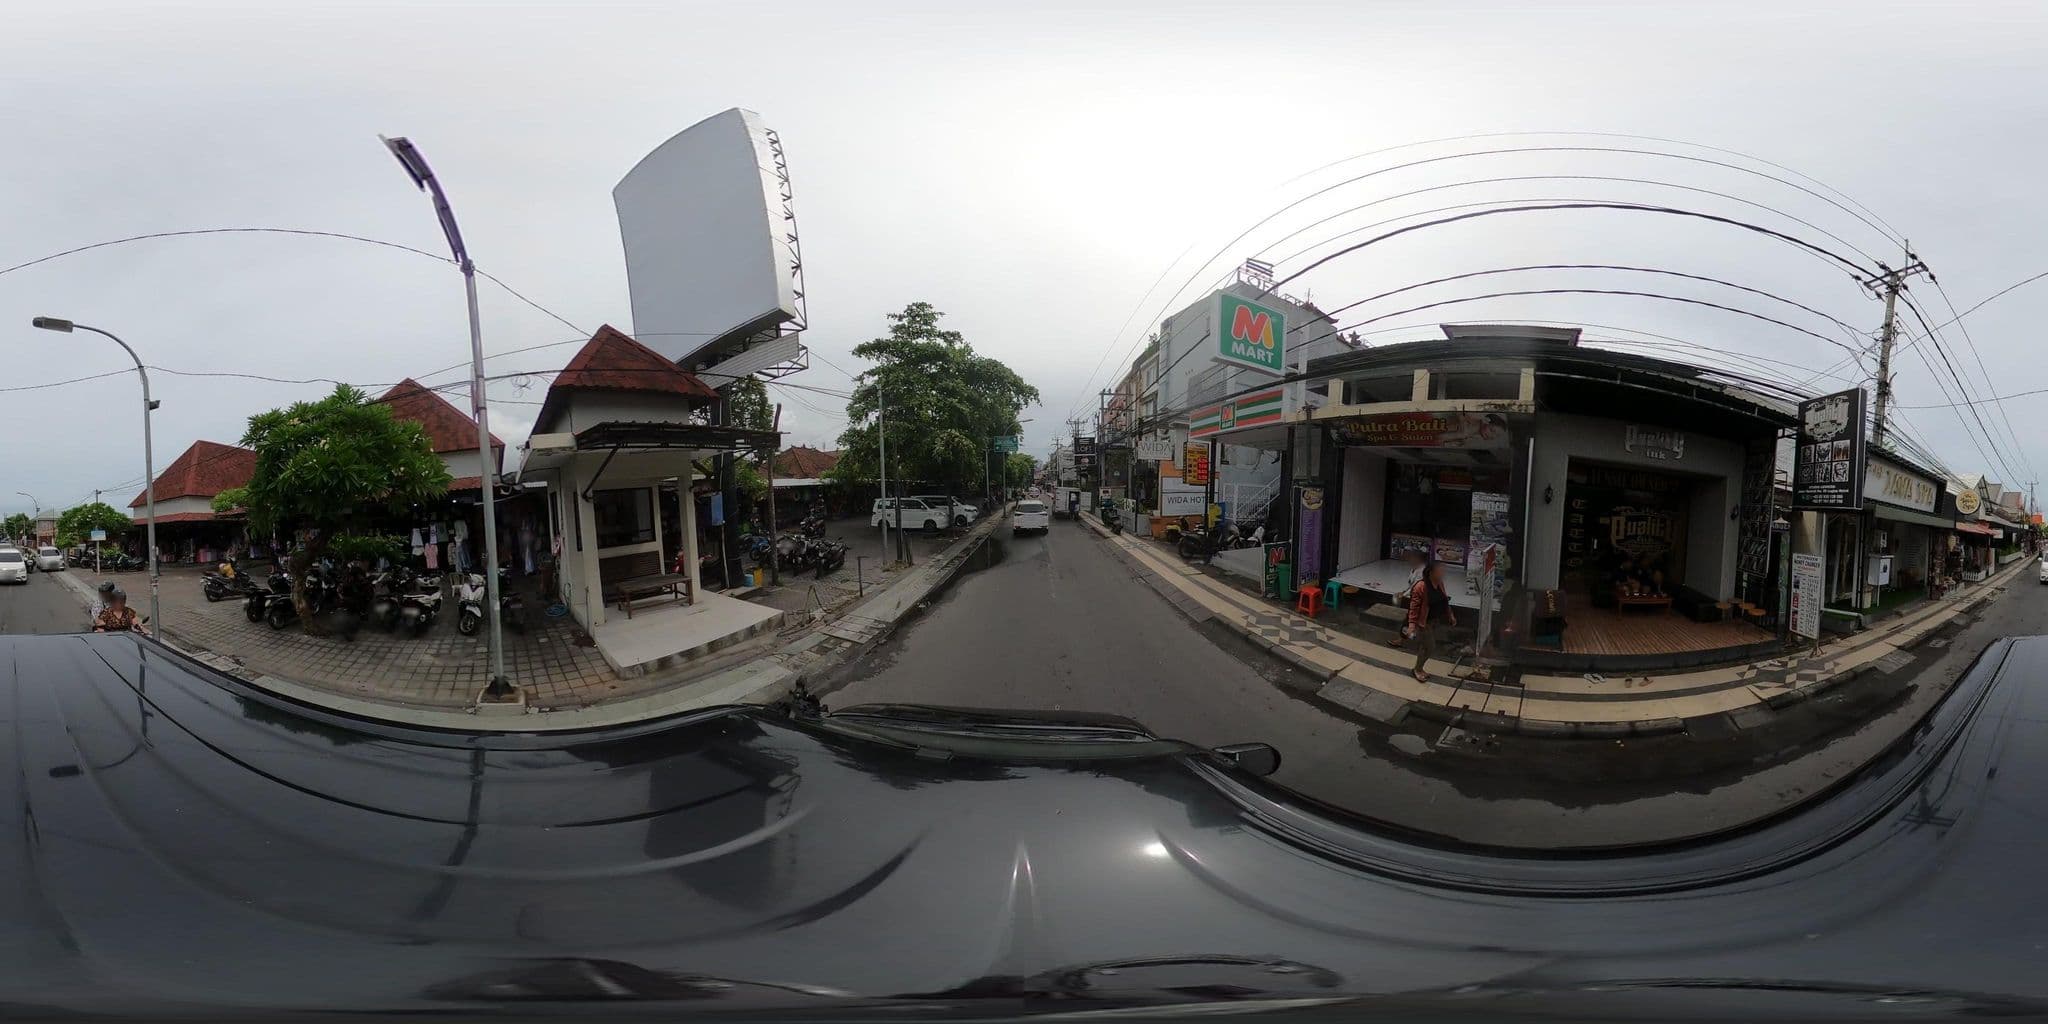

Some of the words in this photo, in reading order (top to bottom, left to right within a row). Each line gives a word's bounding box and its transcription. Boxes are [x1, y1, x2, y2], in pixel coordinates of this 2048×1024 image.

[1231, 341, 1274, 364] MART
[1345, 421, 1398, 433] Putra
[1401, 416, 1449, 433] Bali
[1367, 433, 1387, 443] Spa
[1401, 433, 1433, 442] Salon
[1141, 443, 1172, 453] WIDA
[1167, 496, 1188, 505] WIDA
[1190, 496, 1207, 504] HOT
